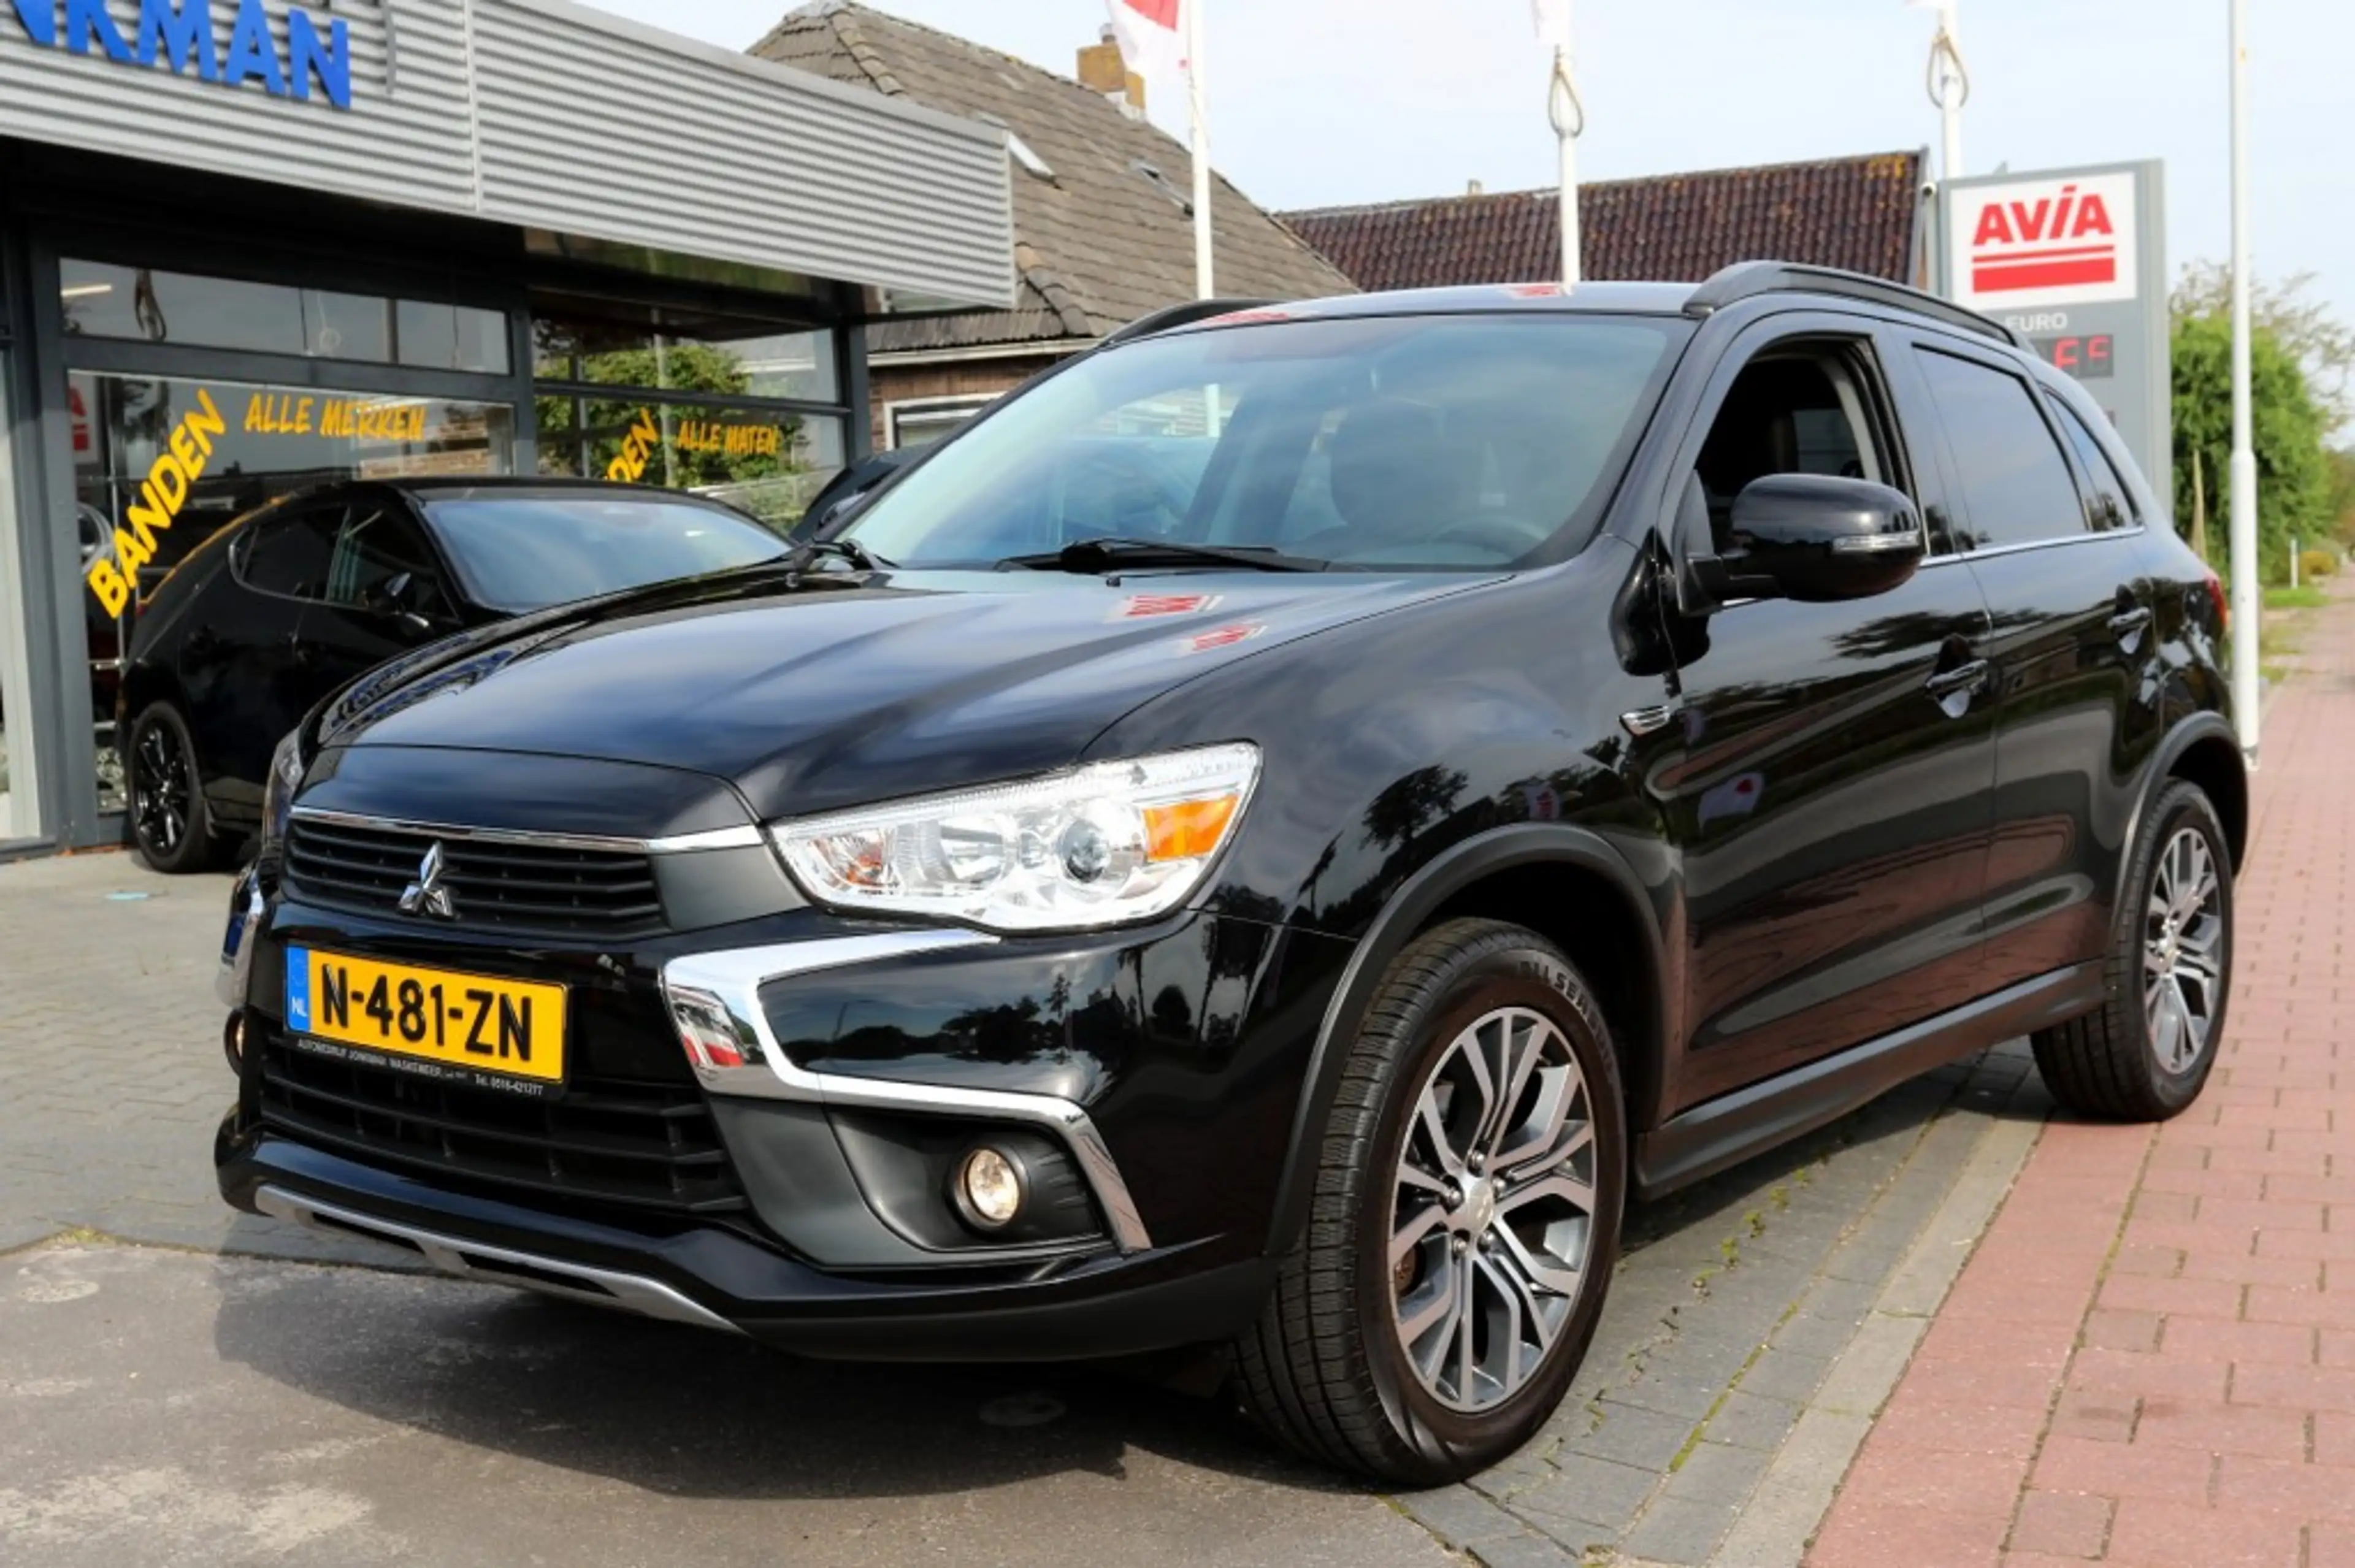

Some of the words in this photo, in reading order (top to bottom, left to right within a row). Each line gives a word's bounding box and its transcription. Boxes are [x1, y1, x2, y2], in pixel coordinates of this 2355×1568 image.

[1972, 185, 2114, 245] AVIA
[2004, 312, 2069, 332] EURO
[243, 392, 314, 434] ALLE
[320, 398, 426, 441] MERKEN
[677, 420, 721, 451] ALLE
[724, 424, 779, 455] MATEN
[88, 388, 226, 619] BANDEN
[291, 996, 308, 1018] NL
[321, 963, 532, 1061] N-481-ZN
